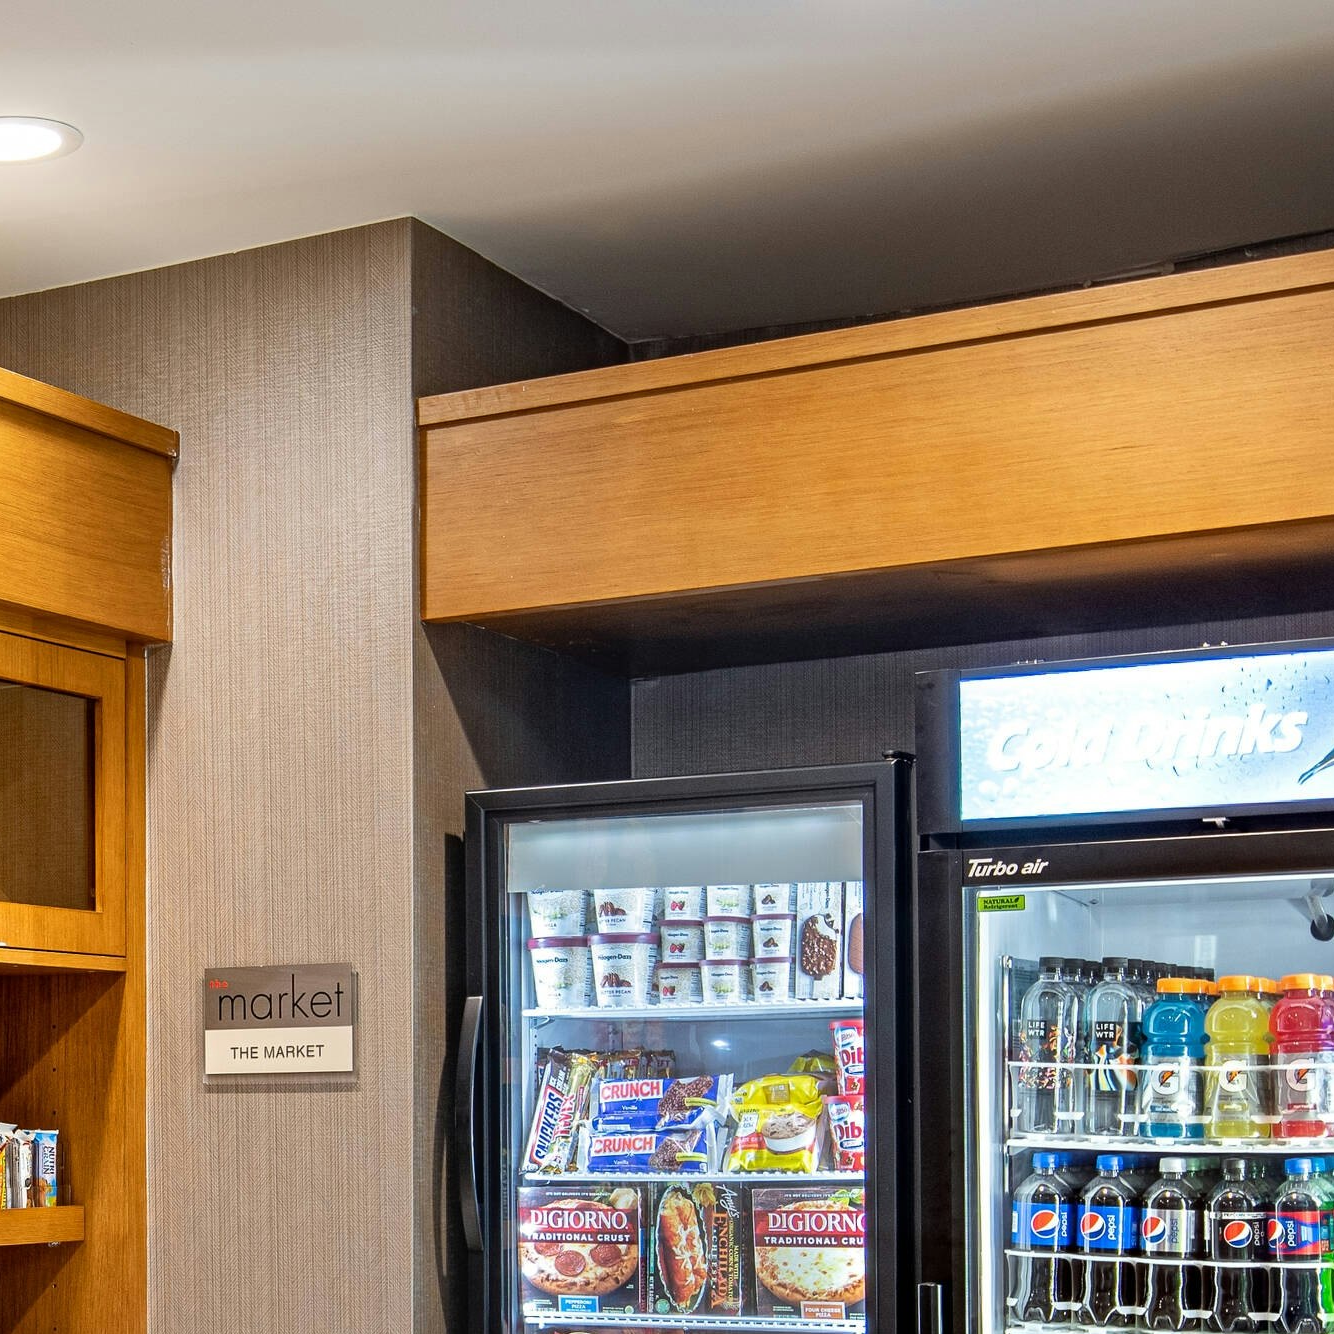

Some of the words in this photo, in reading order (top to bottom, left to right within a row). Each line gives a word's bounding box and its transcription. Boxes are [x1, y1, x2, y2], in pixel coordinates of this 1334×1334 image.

[988, 722, 1115, 772] Cold
[1116, 705, 1308, 758] Drinks
[968, 858, 1019, 877] Turbo
[1021, 858, 1049, 875] air
[210, 979, 228, 989] the
[219, 974, 344, 1021] market
[1028, 1021, 1046, 1029] LIFE
[1028, 1029, 1045, 1037] WTR
[1096, 1023, 1115, 1031] LIFE
[1096, 1031, 1115, 1039] WTR
[230, 1047, 259, 1059] THE
[264, 1045, 325, 1059] MARKET
[601, 1081, 661, 1100] CRUNCH
[534, 1092, 564, 1161] SNICKERS
[592, 1136, 655, 1154] CRUNCH
[530, 1210, 629, 1230] DIGIORNO
[1107, 1214, 1116, 1241] pepsi
[528, 1231, 594, 1242] TRADITIONAL
[597, 1232, 631, 1243] CRUST
[1170, 1218, 1179, 1244] pepsi
[1253, 1221, 1261, 1246] pepsi
[1287, 1220, 1295, 1246] pepsi
